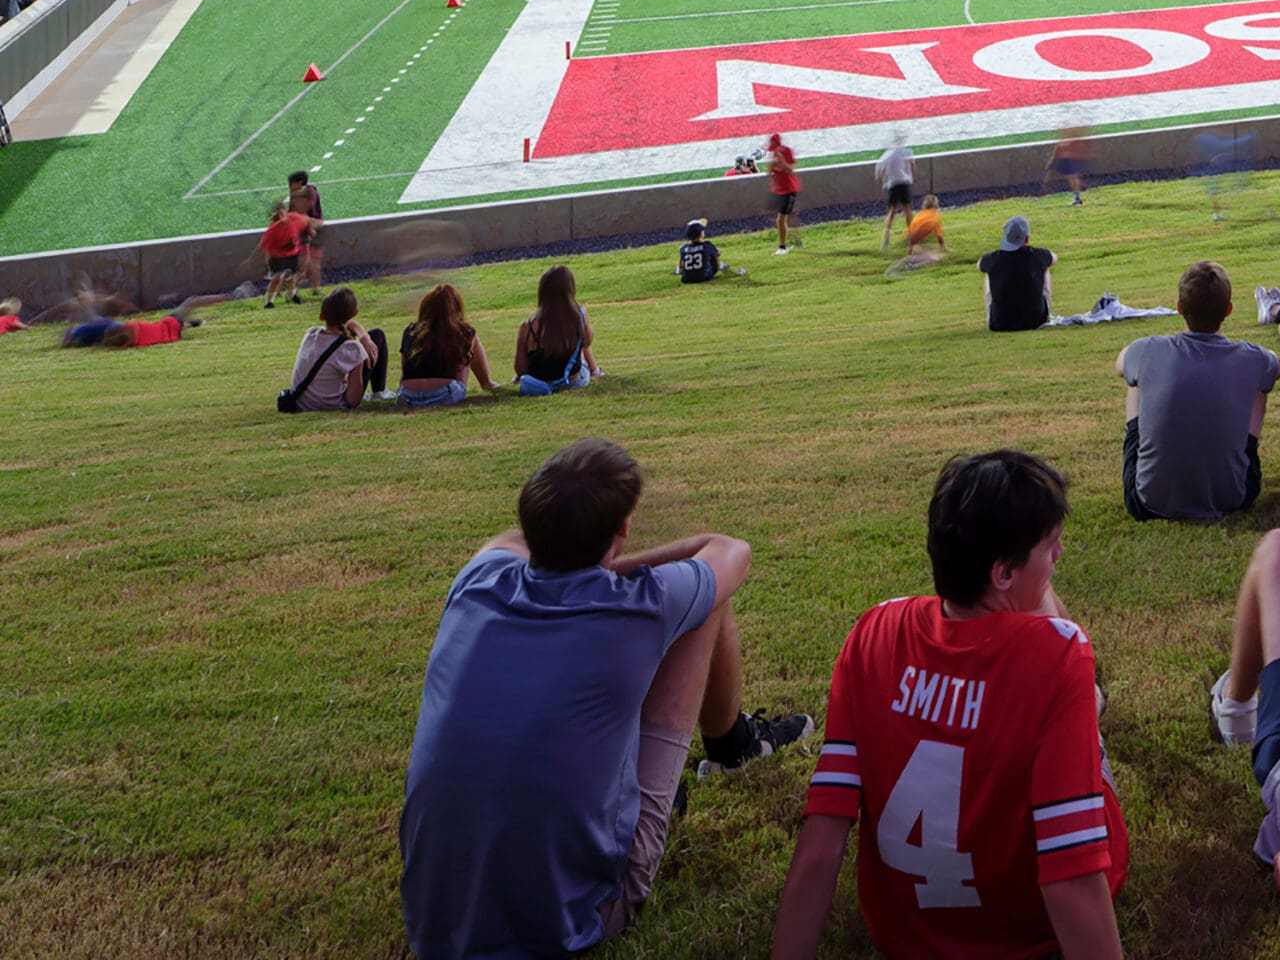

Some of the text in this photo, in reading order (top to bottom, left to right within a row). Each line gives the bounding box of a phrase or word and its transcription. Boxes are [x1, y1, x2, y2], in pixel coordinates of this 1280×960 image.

[684, 253, 703, 270] 23
[891, 665, 986, 730] SMITH
[876, 739, 982, 910] 4
